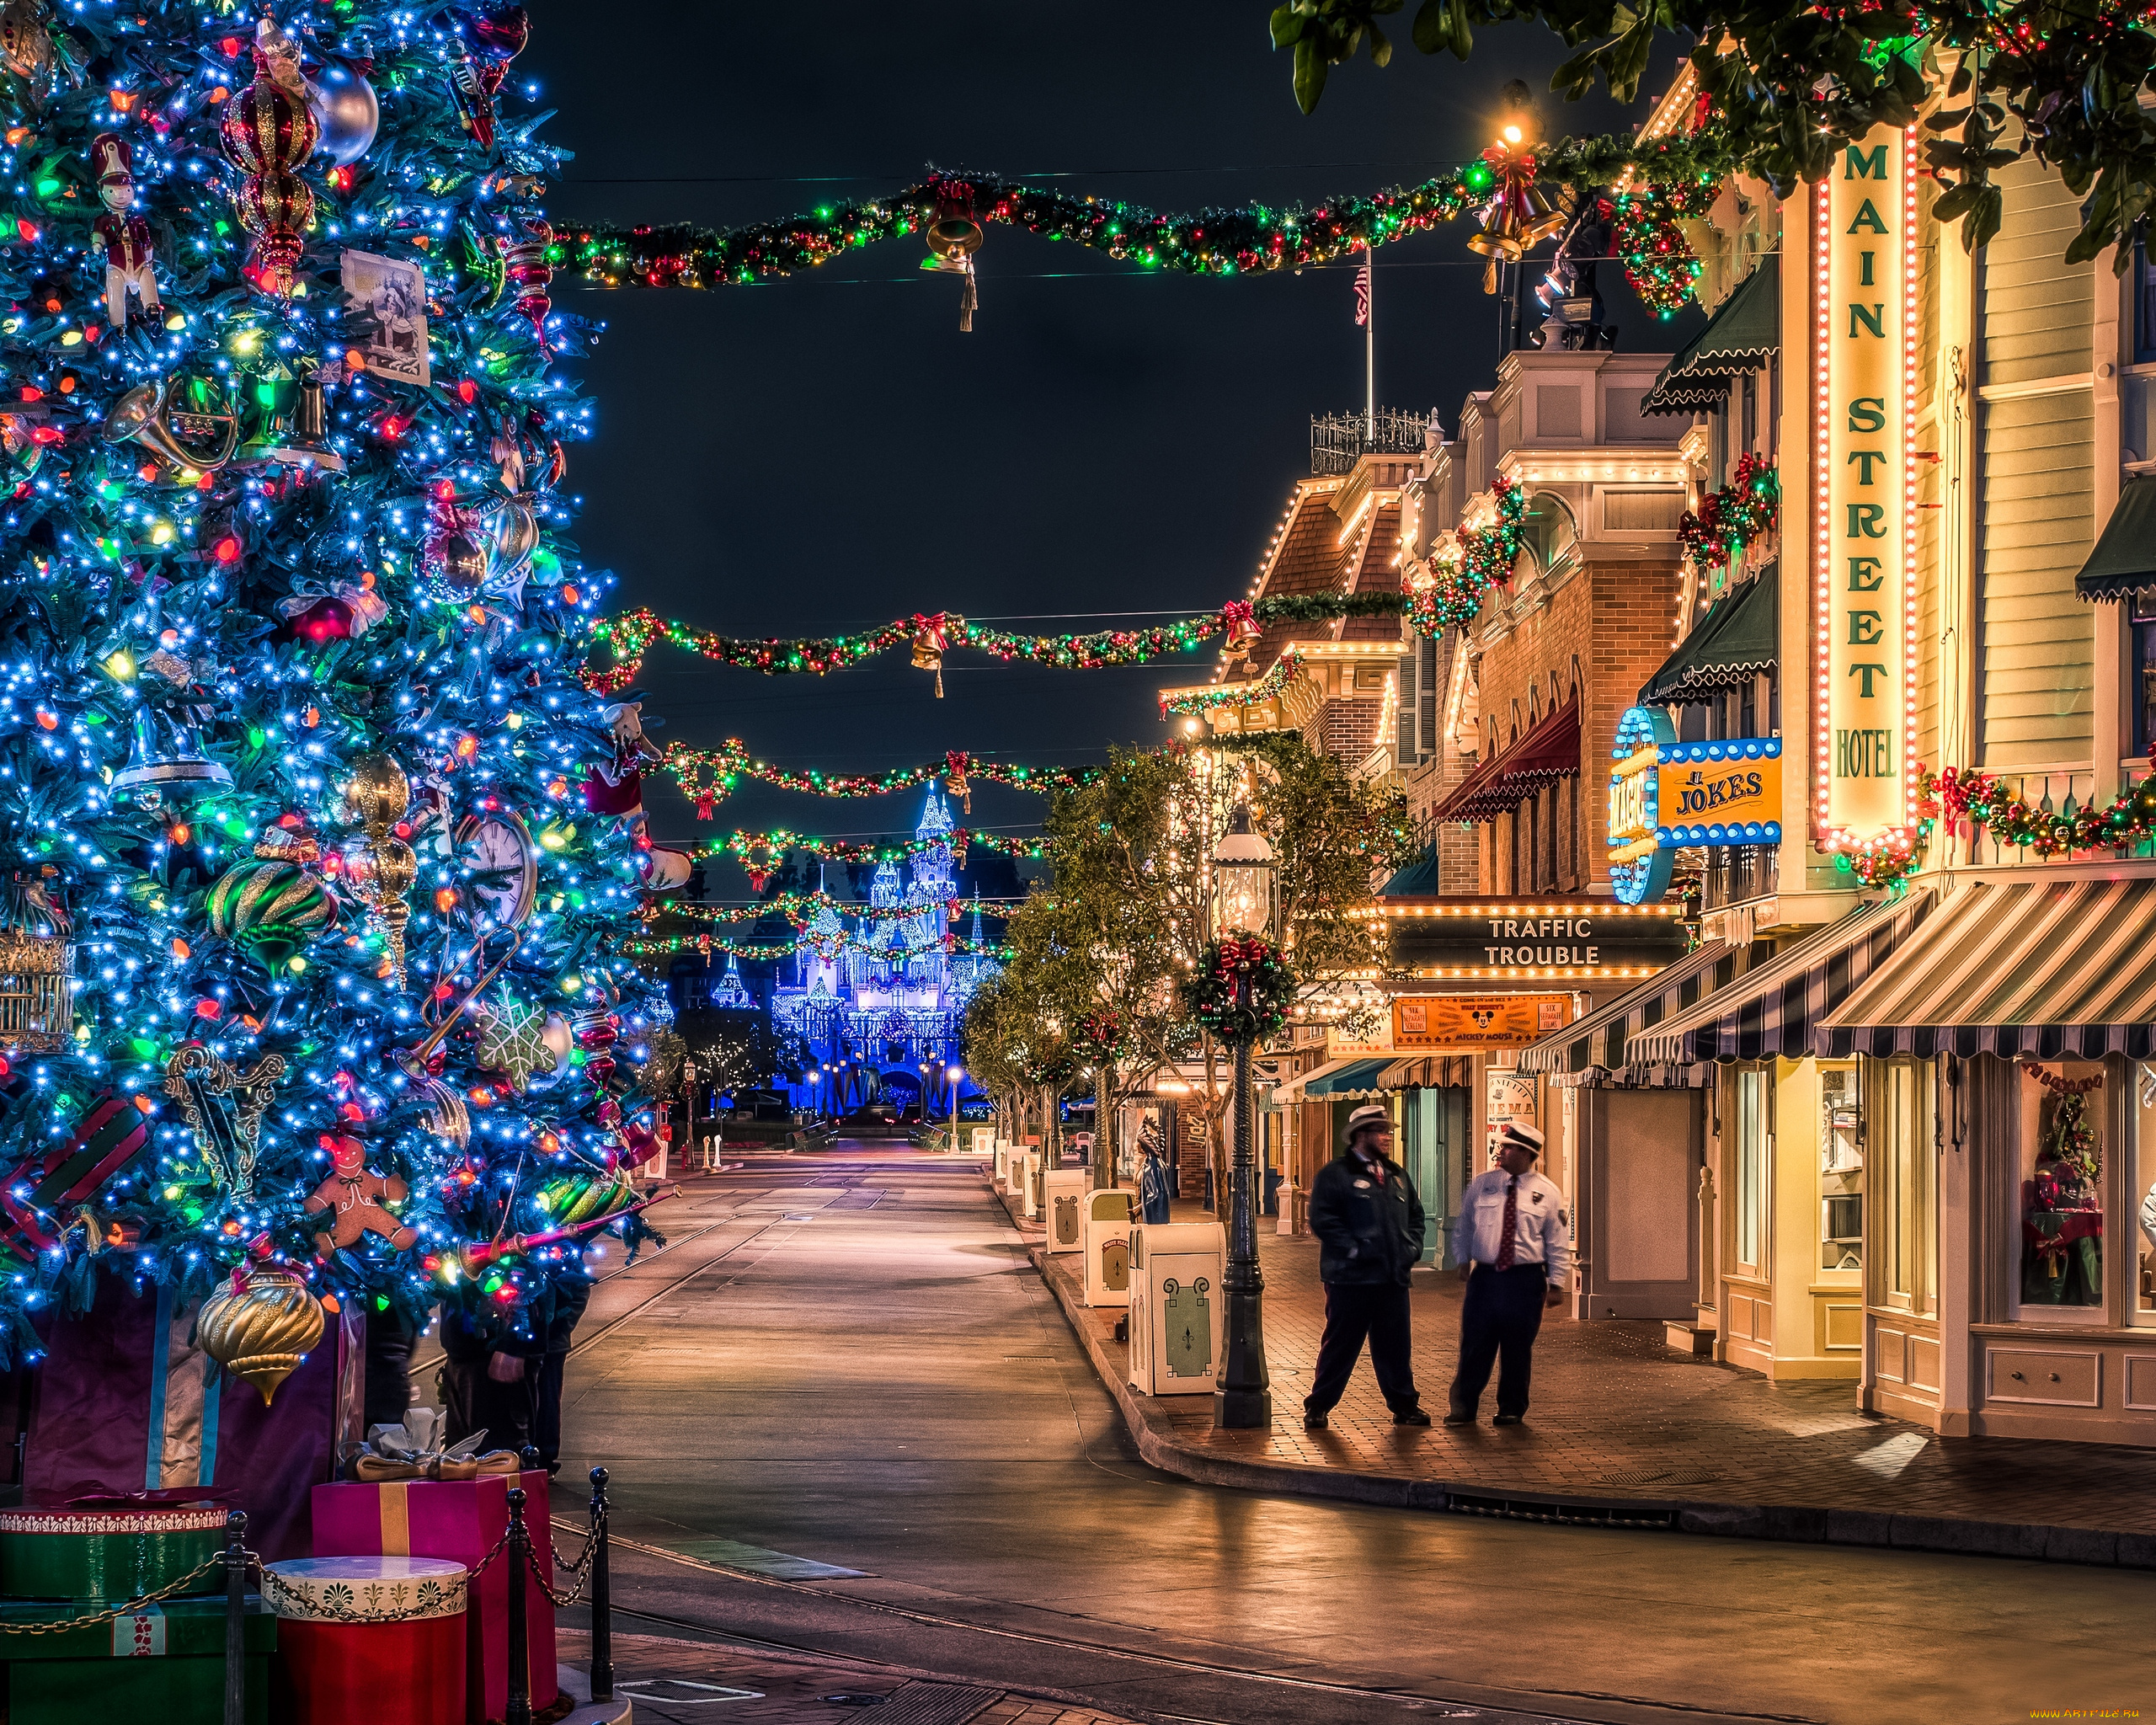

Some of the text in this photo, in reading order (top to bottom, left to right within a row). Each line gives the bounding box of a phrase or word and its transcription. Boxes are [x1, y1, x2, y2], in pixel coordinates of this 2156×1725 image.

[1844, 145, 1889, 697] MAIN STREET
[1836, 729, 1897, 778] HOTEL
[1675, 772, 1764, 815] JOKES
[1488, 918, 1591, 937] TRAFFIC
[1484, 946, 1600, 965] TROUBLE
[1405, 1022, 1424, 1030] SCREENS
[1489, 1103, 1534, 1115] NEMA
